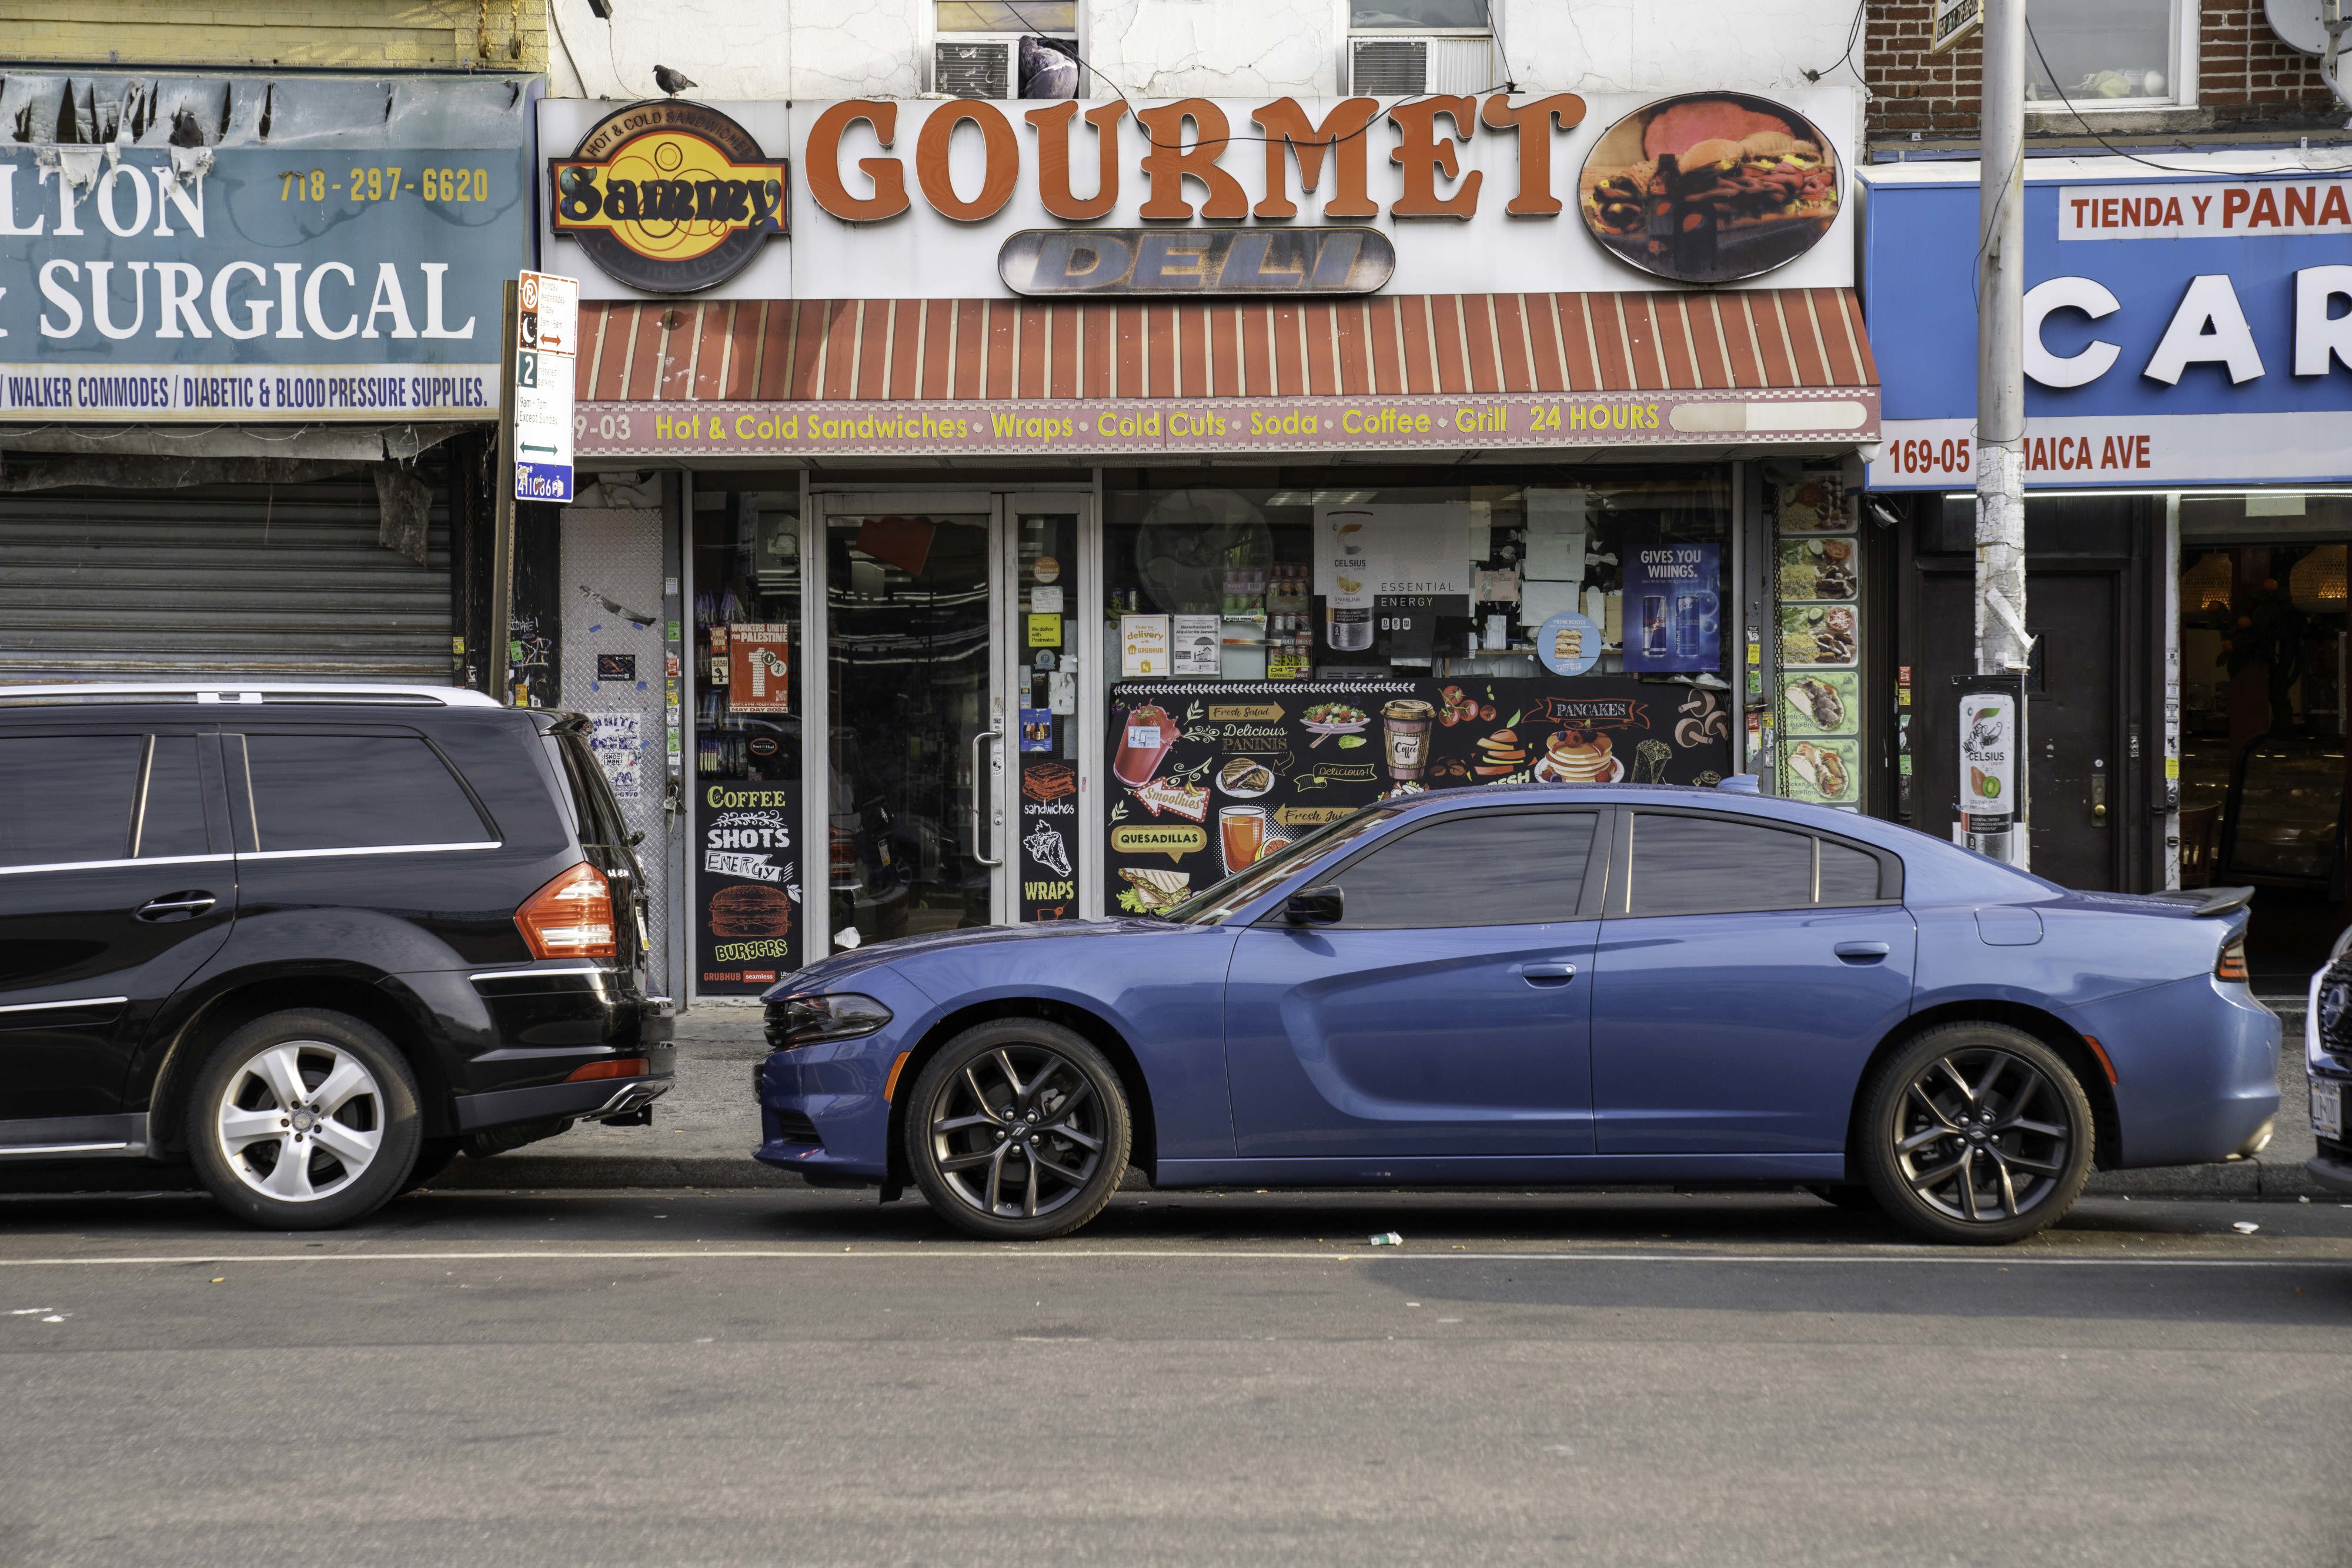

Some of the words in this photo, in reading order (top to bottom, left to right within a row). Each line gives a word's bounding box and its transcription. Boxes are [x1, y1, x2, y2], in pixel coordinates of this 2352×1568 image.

[586, 131, 613, 157] HOT
[614, 126, 624, 137] &
[624, 111, 662, 132] COLD
[666, 110, 752, 157] SANDWICHES
[805, 94, 1587, 221] GOURMET
[560, 166, 782, 230] Sammy
[2070, 196, 2183, 228] TIENDA
[2191, 196, 2213, 225] Y
[2223, 185, 2352, 228] PANA
[1034, 235, 1363, 289] DELI
[541, 281, 558, 292] Monday
[39, 259, 475, 340] SURGICAL
[541, 293, 566, 305] Wednesday
[540, 303, 554, 315] Friday
[524, 355, 534, 385] 2
[537, 367, 557, 377] metered
[537, 377, 554, 390] parking
[8, 377, 72, 407] WALKER
[78, 375, 168, 406] COMMODES
[184, 377, 253, 407] DIABETIC
[259, 383, 270, 408] &
[275, 376, 325, 407] BLOOD
[330, 376, 406, 407] PRESSURE
[412, 376, 487, 407] SUPPLIES.
[520, 396, 532, 408] 9am
[537, 398, 547, 411] 7pm
[519, 411, 538, 423] Except
[539, 413, 558, 426] Sunday
[656, 414, 701, 440] Hot
[709, 416, 726, 440] &
[735, 414, 798, 440] Cold
[807, 413, 967, 440] Sandwiches
[991, 413, 1073, 444] Wraps
[1097, 412, 1160, 438] Cold
[1168, 412, 1226, 438] Cuts
[1250, 410, 1318, 435] Soda
[1342, 409, 1431, 435] Coffee
[1455, 406, 1507, 433] Grill
[1529, 405, 1561, 430] 24
[1570, 404, 1659, 431] HOURS
[1889, 439, 1970, 474] 169-05
[2100, 435, 2151, 469] AVE
[1641, 550, 1673, 563] GIVES
[1676, 550, 1701, 563] YOU
[1648, 564, 1698, 578] WIIINGS.
[1381, 583, 1454, 591] ESSENTIAL
[1381, 597, 1433, 606] ENERGY
[731, 624, 765, 632] WORKERS
[767, 624, 787, 632] UNITE
[741, 632, 787, 643] PALESTINE
[1127, 630, 1164, 641] delivery
[1212, 707, 1241, 717] Fresh
[1244, 707, 1270, 717] Salad
[1557, 703, 1626, 717] PANCAKES
[1223, 724, 1287, 738] Delicious
[1222, 738, 1288, 751] PANINIS
[1395, 741, 1418, 760] Coffee
[1969, 752, 2004, 761] CELSIUS
[1318, 767, 1369, 777] Delicious!
[707, 785, 786, 808] COFFEE
[1144, 787, 1202, 811] Smoothies
[1024, 797, 1074, 815] sandwiches
[1284, 810, 1322, 823] Fresh
[707, 828, 790, 849] SHOTS
[1121, 833, 1198, 844] QUESADILLAS
[1024, 881, 1074, 900] WRAPS
[704, 972, 741, 981] GRUBHUB
